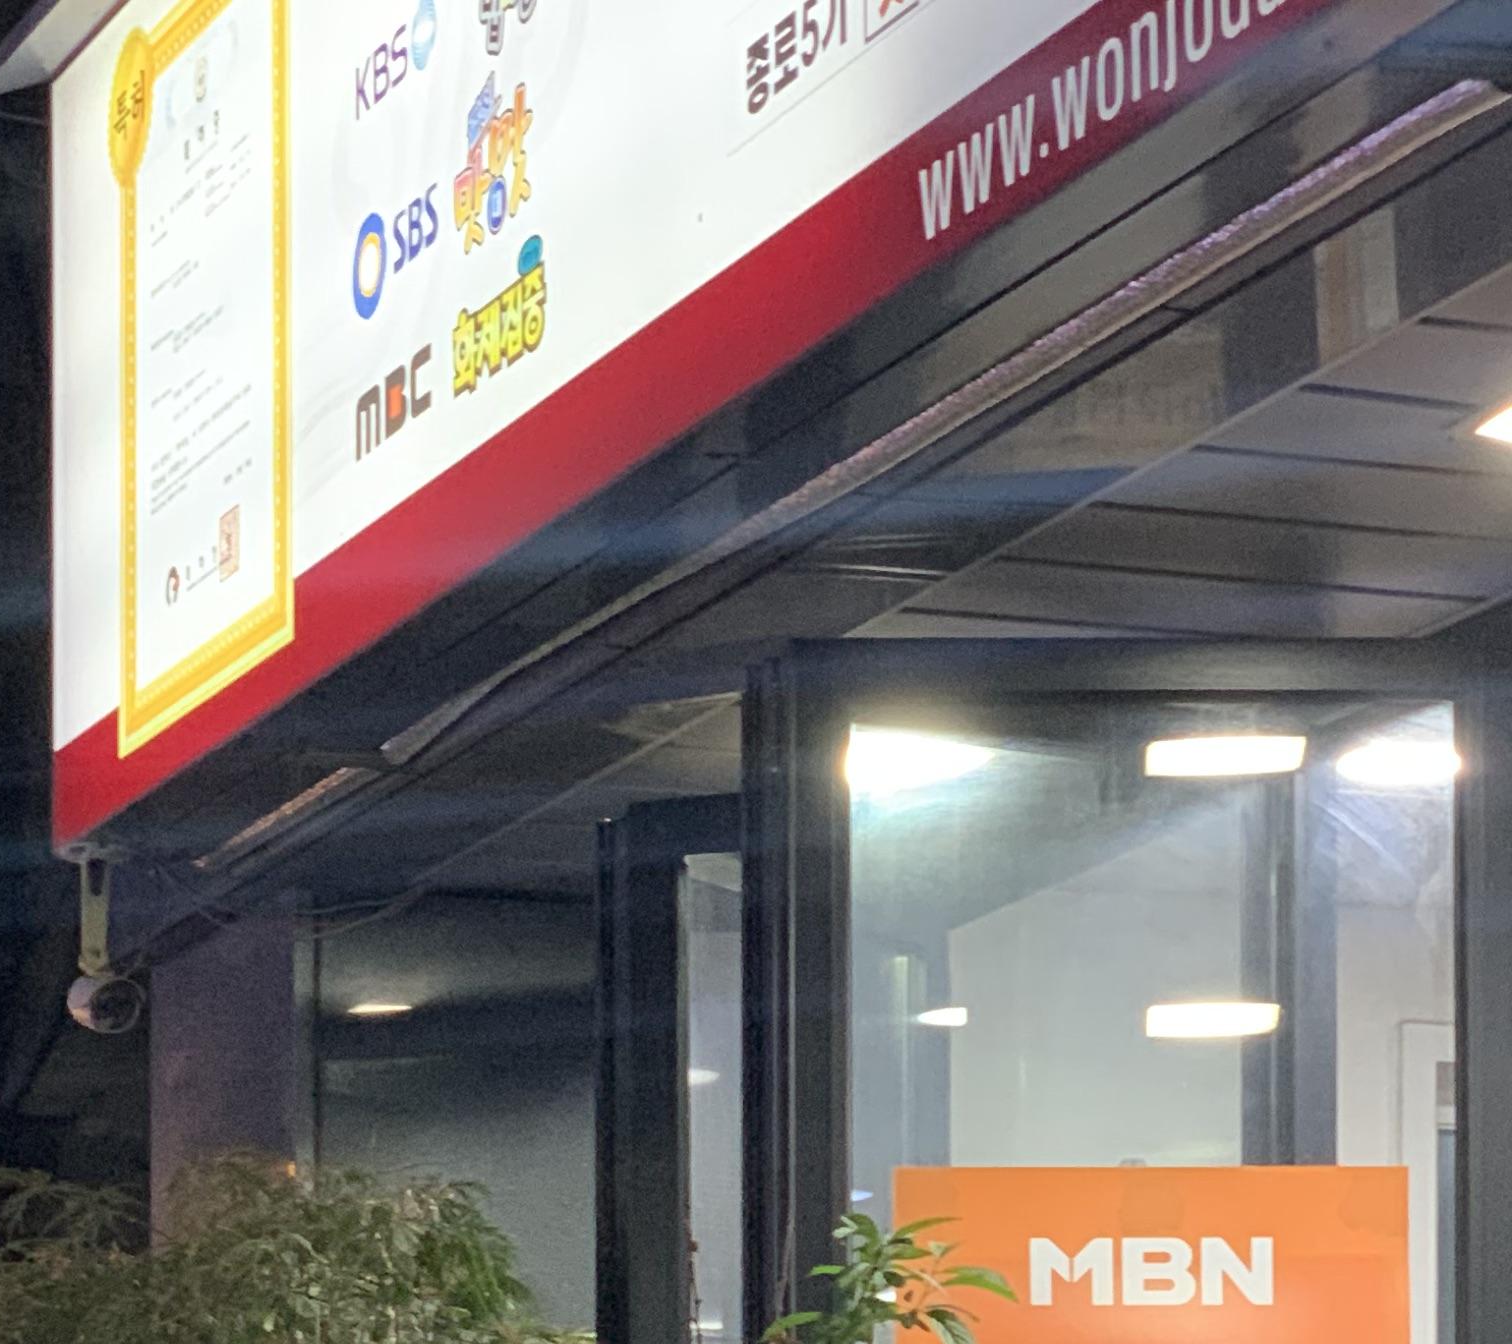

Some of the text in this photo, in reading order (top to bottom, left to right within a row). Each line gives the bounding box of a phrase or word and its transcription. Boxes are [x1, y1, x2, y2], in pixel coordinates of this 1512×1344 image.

[355, 24, 408, 121] KBS
[392, 182, 439, 275] SBS
[356, 342, 434, 463] MBC
[1028, 1236, 1274, 1307] MBN
